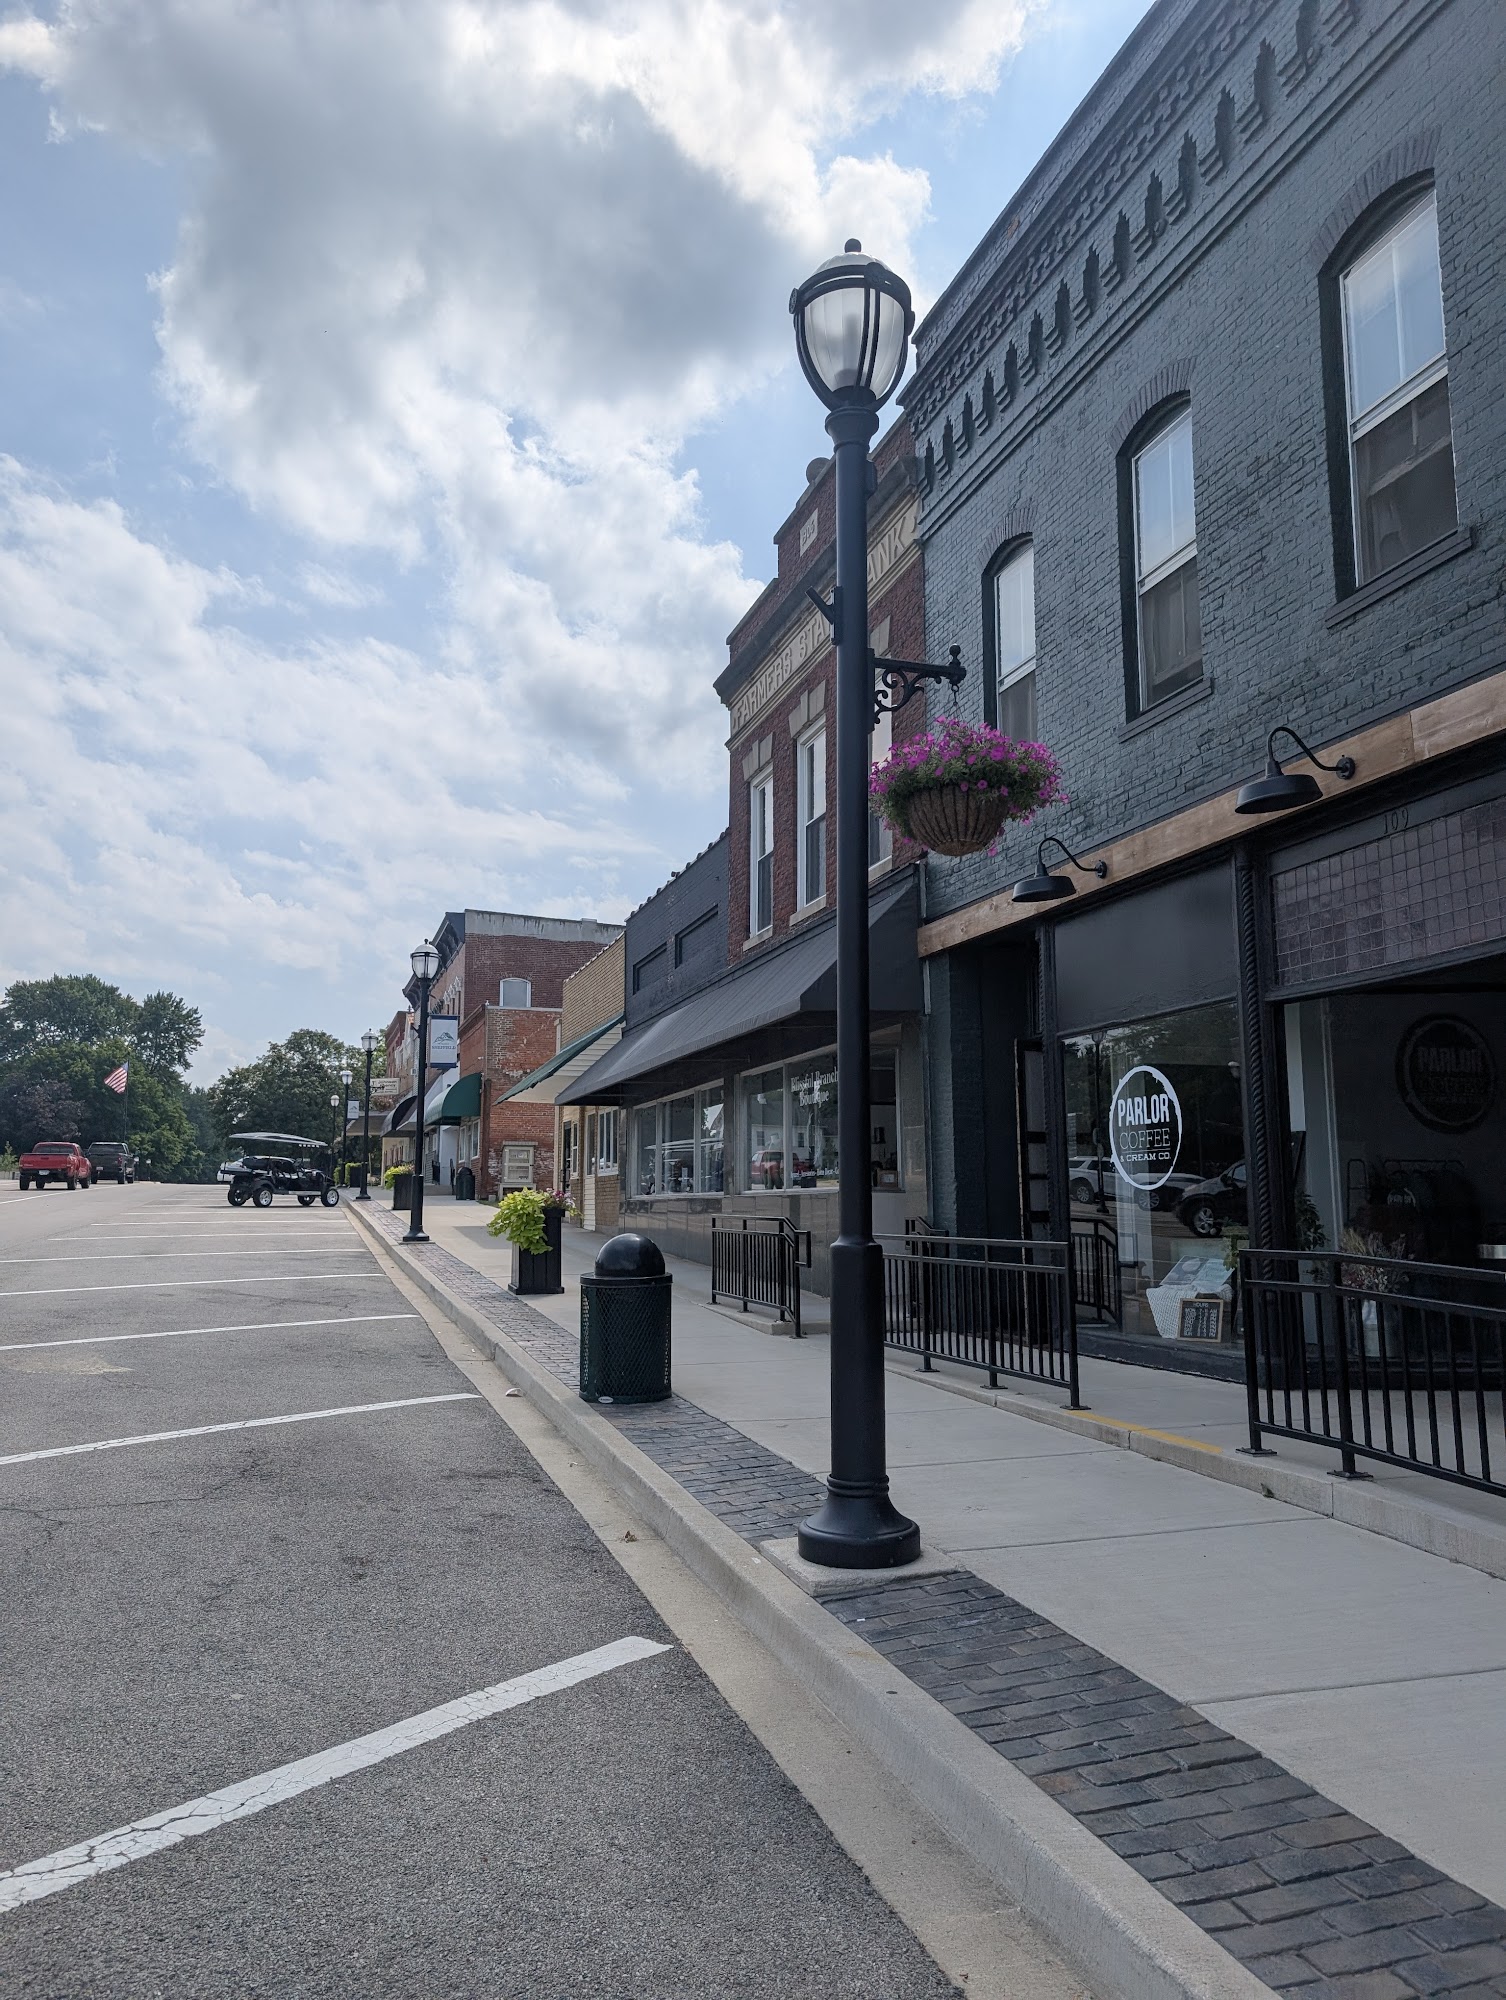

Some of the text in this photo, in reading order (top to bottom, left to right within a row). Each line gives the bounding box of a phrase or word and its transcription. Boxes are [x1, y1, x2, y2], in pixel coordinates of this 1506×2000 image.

[736, 516, 906, 729] FARMERS STA ANK
[1383, 808, 1409, 835] 109
[1117, 1093, 1170, 1127] PARLOR
[1119, 1128, 1171, 1149] COFFEE
[1126, 1153, 1156, 1162] CREAM
[1158, 1152, 1171, 1160] CO.
